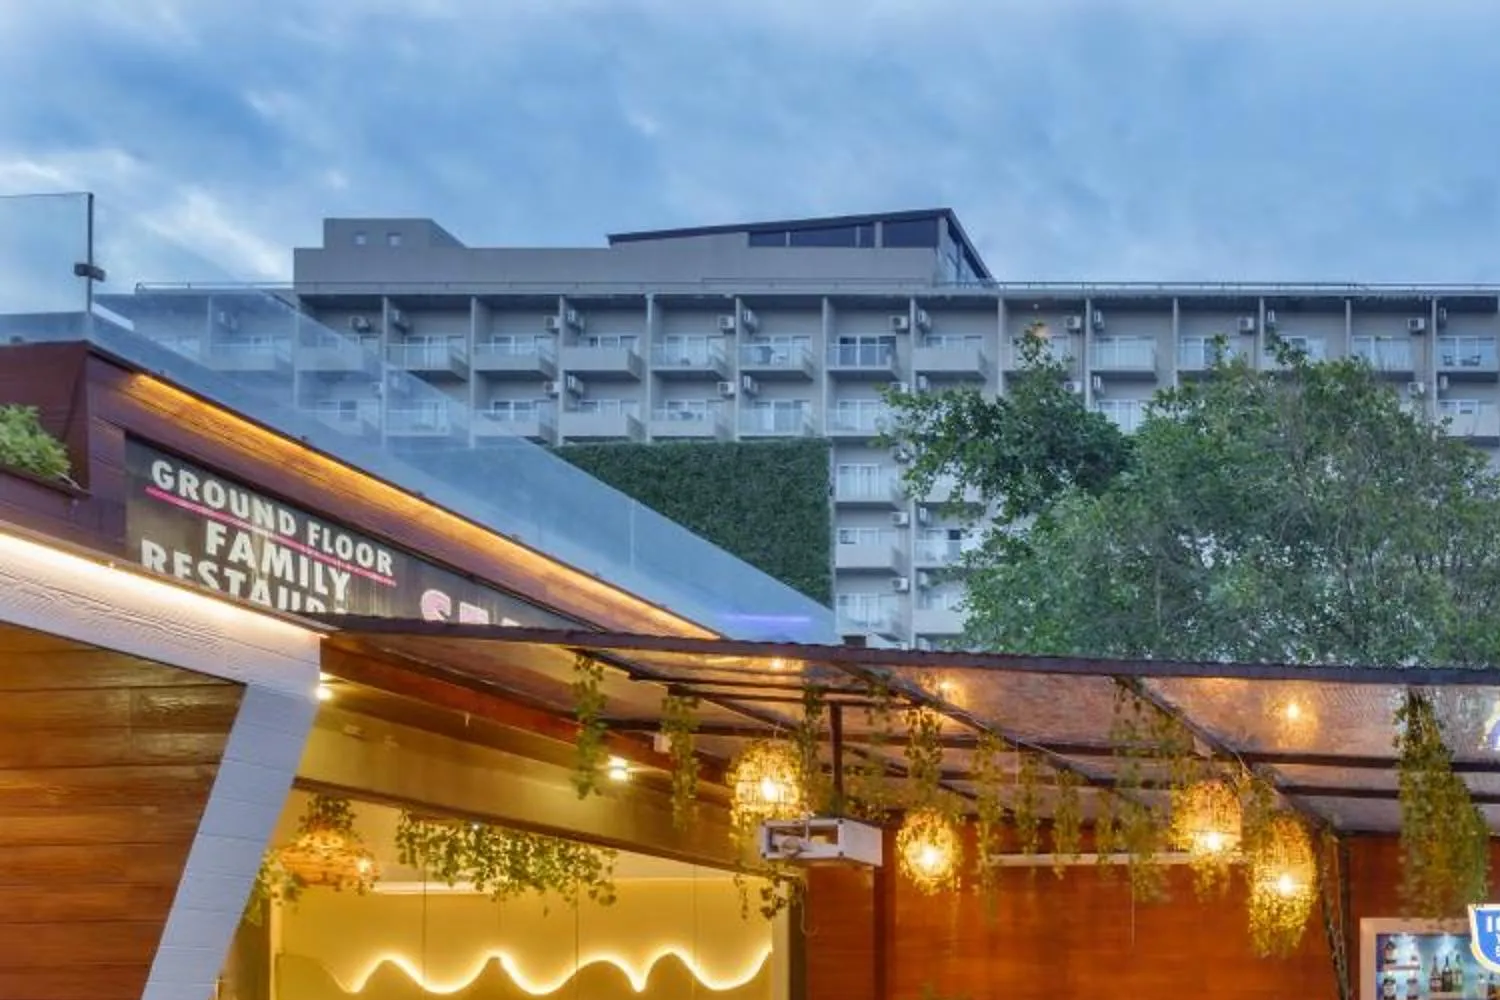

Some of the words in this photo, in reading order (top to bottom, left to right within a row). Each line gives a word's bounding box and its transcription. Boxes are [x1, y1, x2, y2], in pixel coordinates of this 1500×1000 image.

[151, 460, 297, 538] GROUND
[307, 521, 394, 576] FLOOR
[205, 520, 350, 601] FAMILY
